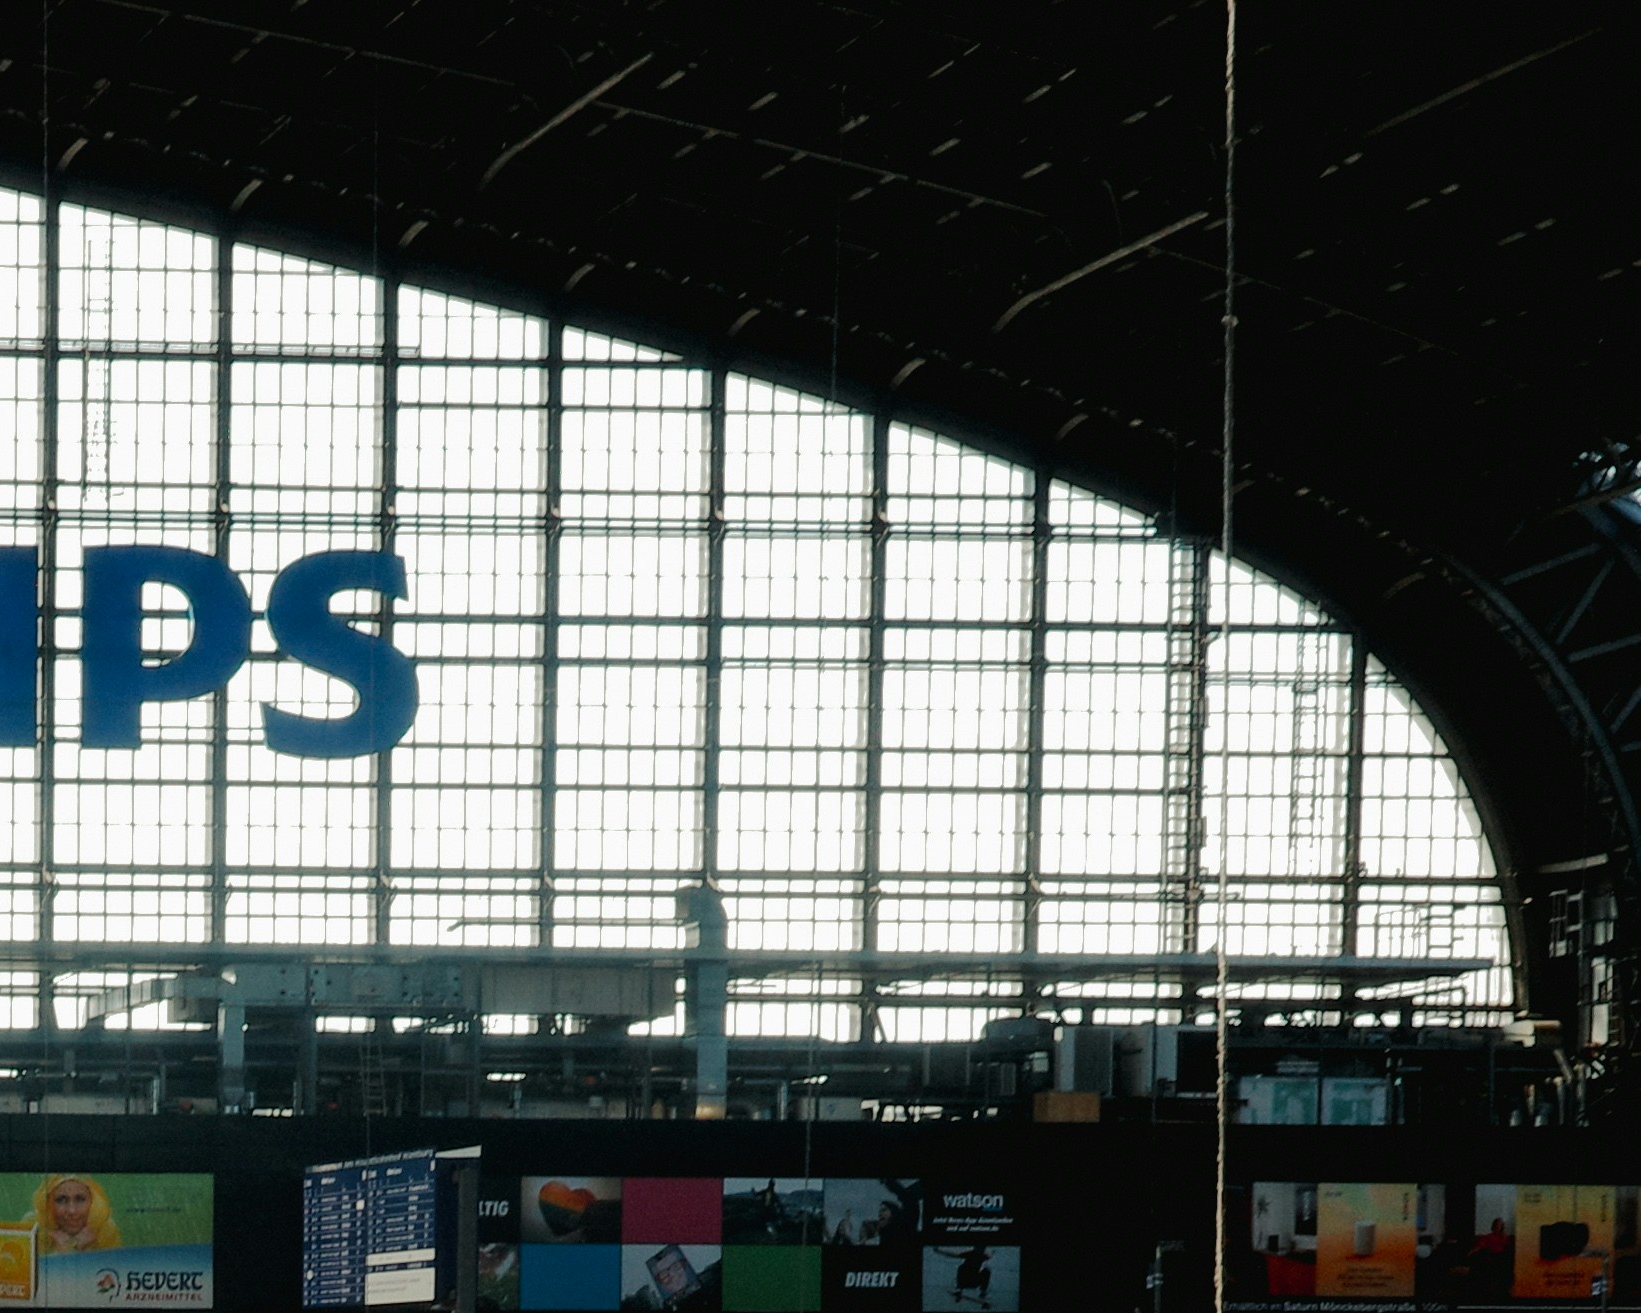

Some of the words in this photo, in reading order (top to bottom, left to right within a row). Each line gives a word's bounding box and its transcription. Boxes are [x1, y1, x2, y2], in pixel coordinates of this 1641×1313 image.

[942, 1192, 1004, 1209] watson
[844, 1270, 900, 1289] DIREKT
[125, 1293, 203, 1302] ARZNEIMITTEL
